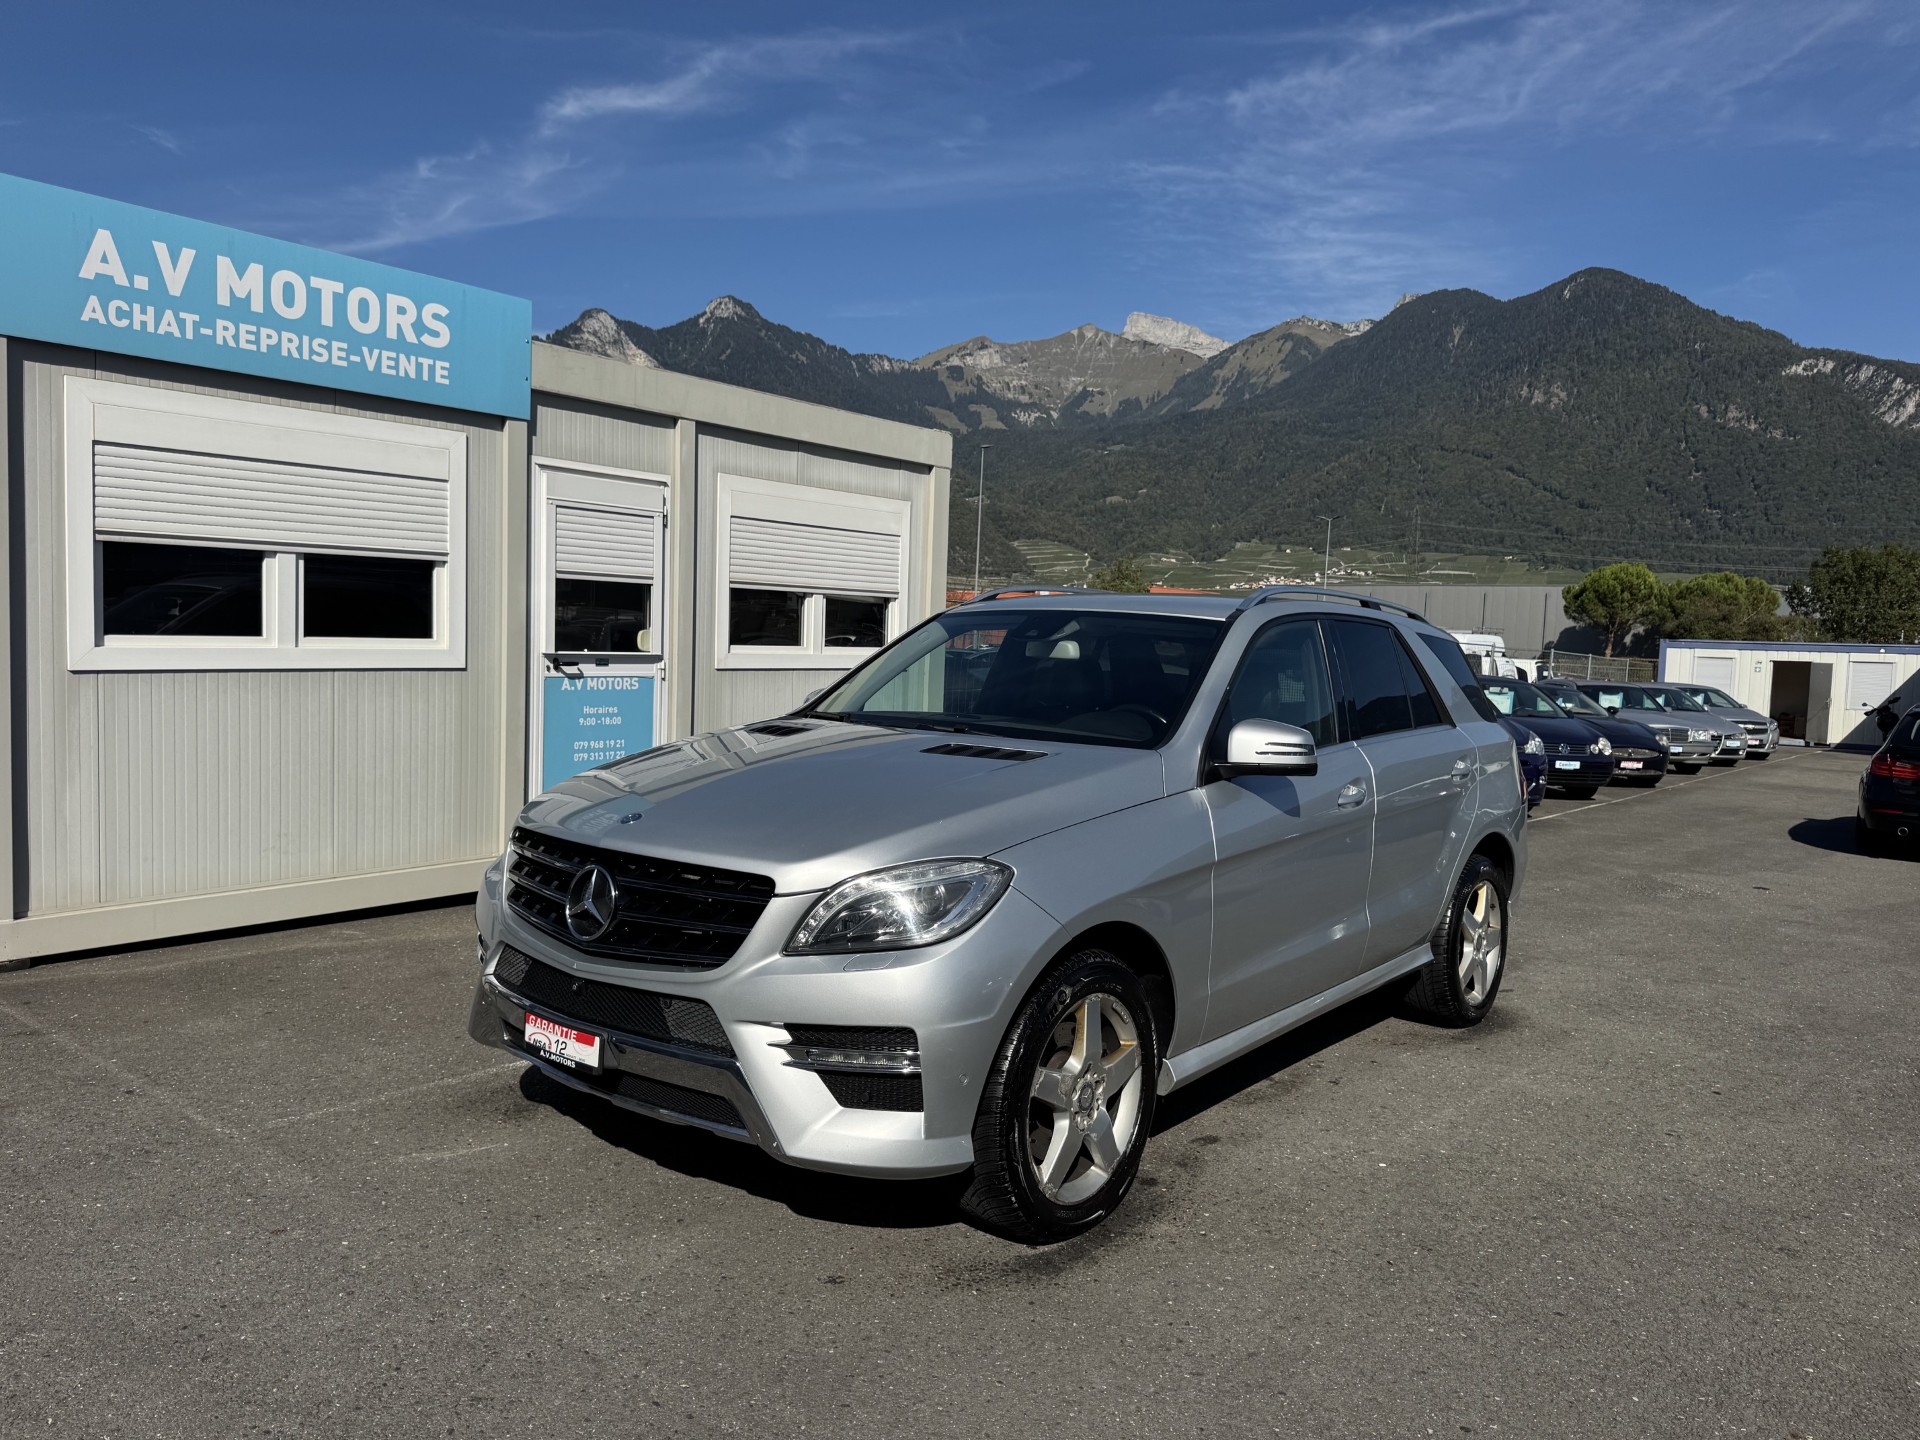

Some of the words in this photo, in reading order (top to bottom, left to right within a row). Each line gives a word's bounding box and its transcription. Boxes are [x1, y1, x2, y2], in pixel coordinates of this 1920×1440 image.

[78, 228, 196, 297] A.V
[217, 254, 450, 349] MOTORS
[81, 295, 450, 385] ACHAT-REPRISE-VENTE
[561, 677, 583, 690] A.V
[587, 677, 639, 691] MOTORS
[583, 705, 618, 714] Horaires
[574, 742, 588, 750] 079
[590, 741, 604, 749] 968
[606, 740, 614, 748] 19
[616, 739, 625, 747] 21
[574, 753, 588, 761] 079
[590, 752, 604, 760] 313
[606, 751, 614, 760] 17
[529, 1015, 577, 1041] GARANTIE
[555, 1039, 567, 1056] 12
